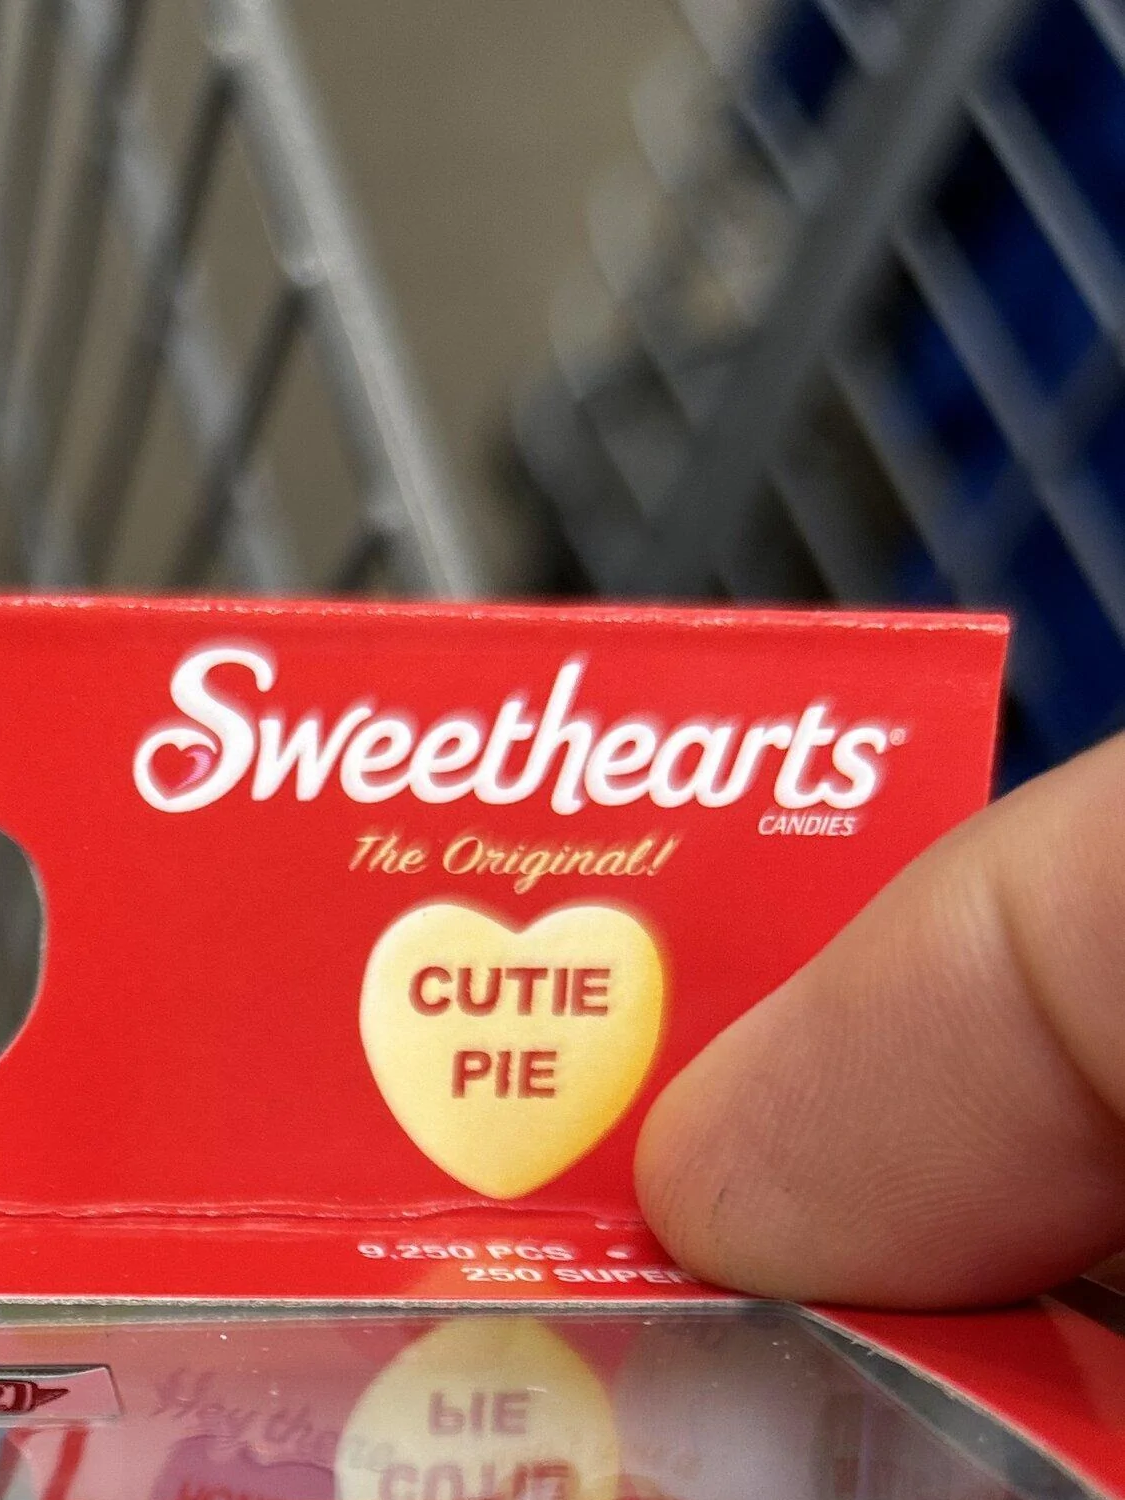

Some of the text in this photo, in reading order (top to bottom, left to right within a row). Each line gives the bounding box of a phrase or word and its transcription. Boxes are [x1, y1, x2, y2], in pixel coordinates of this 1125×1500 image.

[758, 814, 857, 837] CANDIES
[348, 833, 679, 894] The Original!
[407, 965, 612, 1018] CUTIE
[450, 1048, 558, 1100] PIE
[484, 1243, 574, 1262] PCS
[460, 1266, 544, 1283] 250
